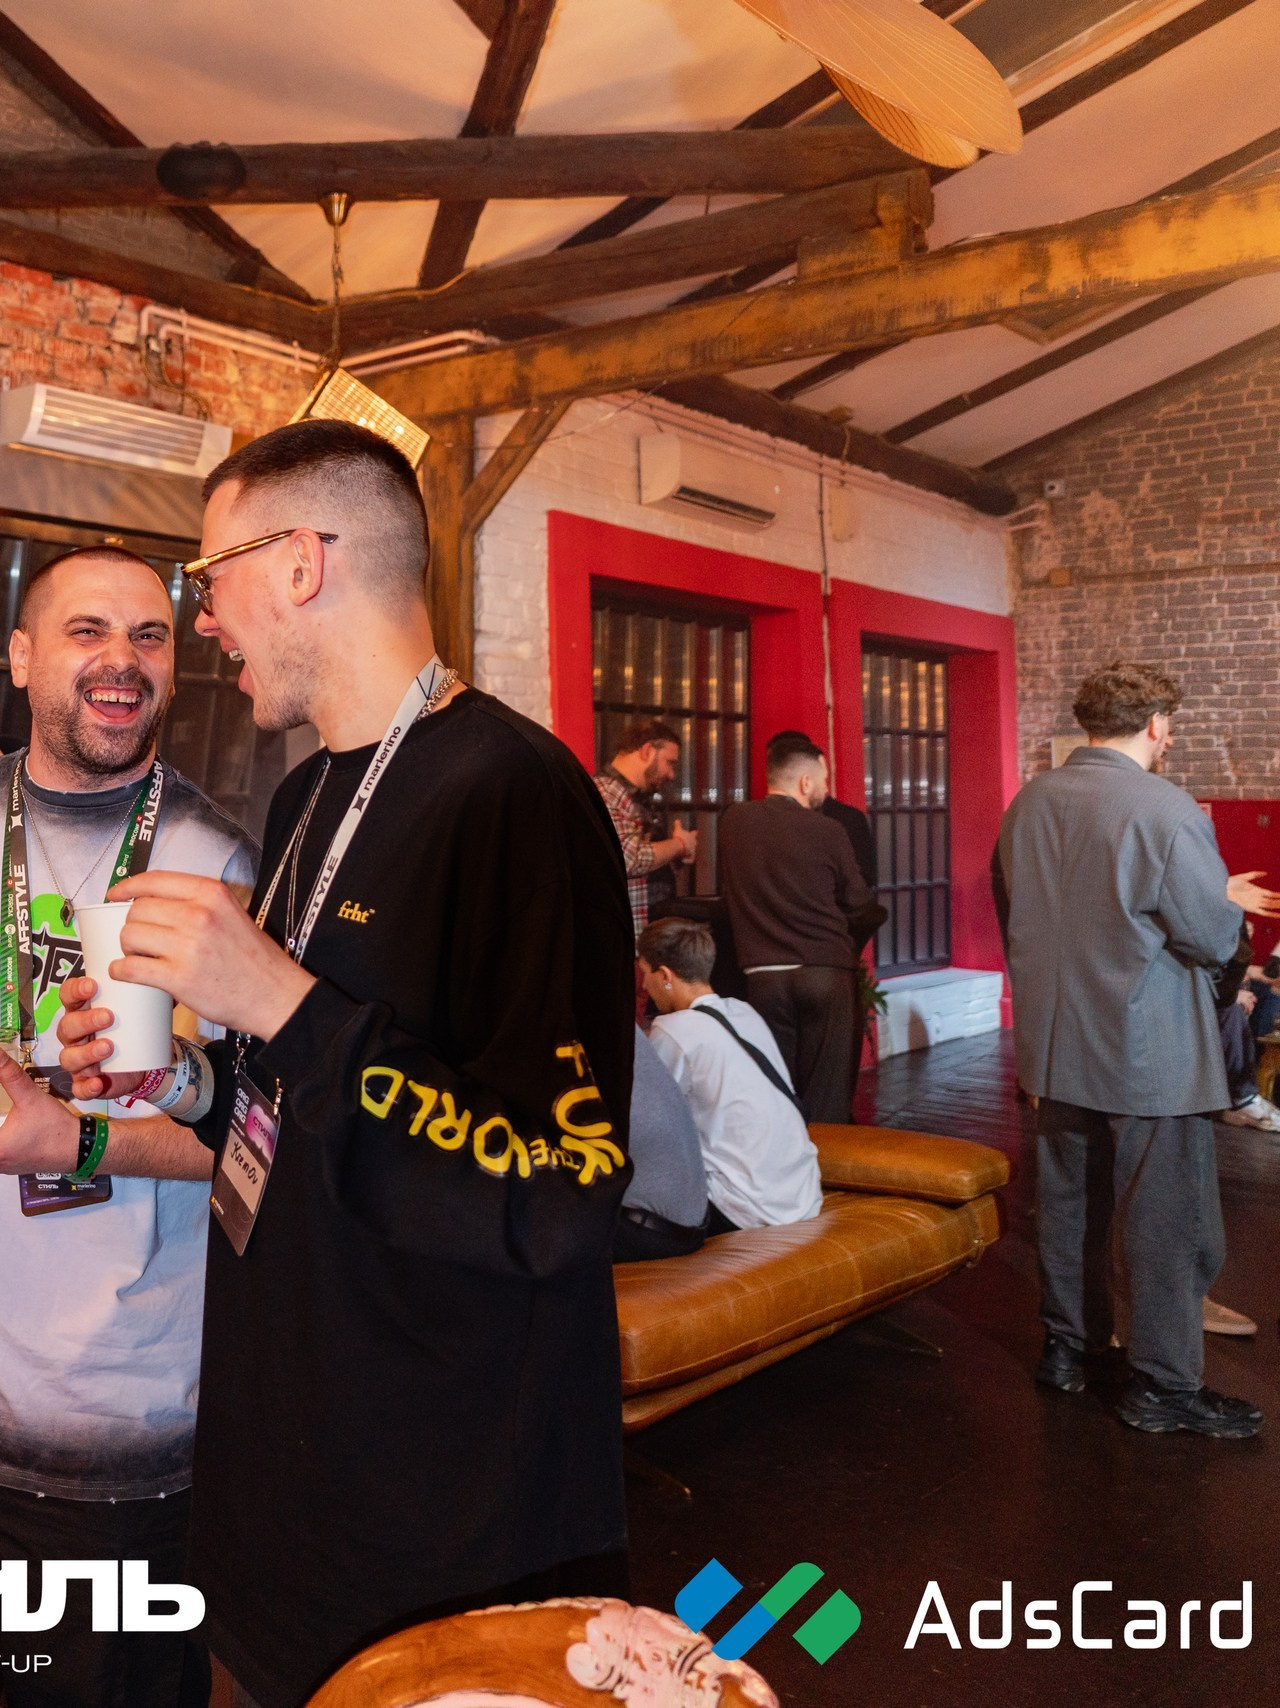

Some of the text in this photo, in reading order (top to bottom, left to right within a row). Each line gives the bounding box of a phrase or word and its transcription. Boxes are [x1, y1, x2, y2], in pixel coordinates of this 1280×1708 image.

[364, 726, 401, 791] marlerino
[138, 760, 164, 842] AFFSTYLE
[14, 864, 31, 955] AFFSTYLE
[233, 1107, 246, 1124] ORG
[235, 1098, 248, 1115] ORG
[237, 1088, 250, 1105] ORG
